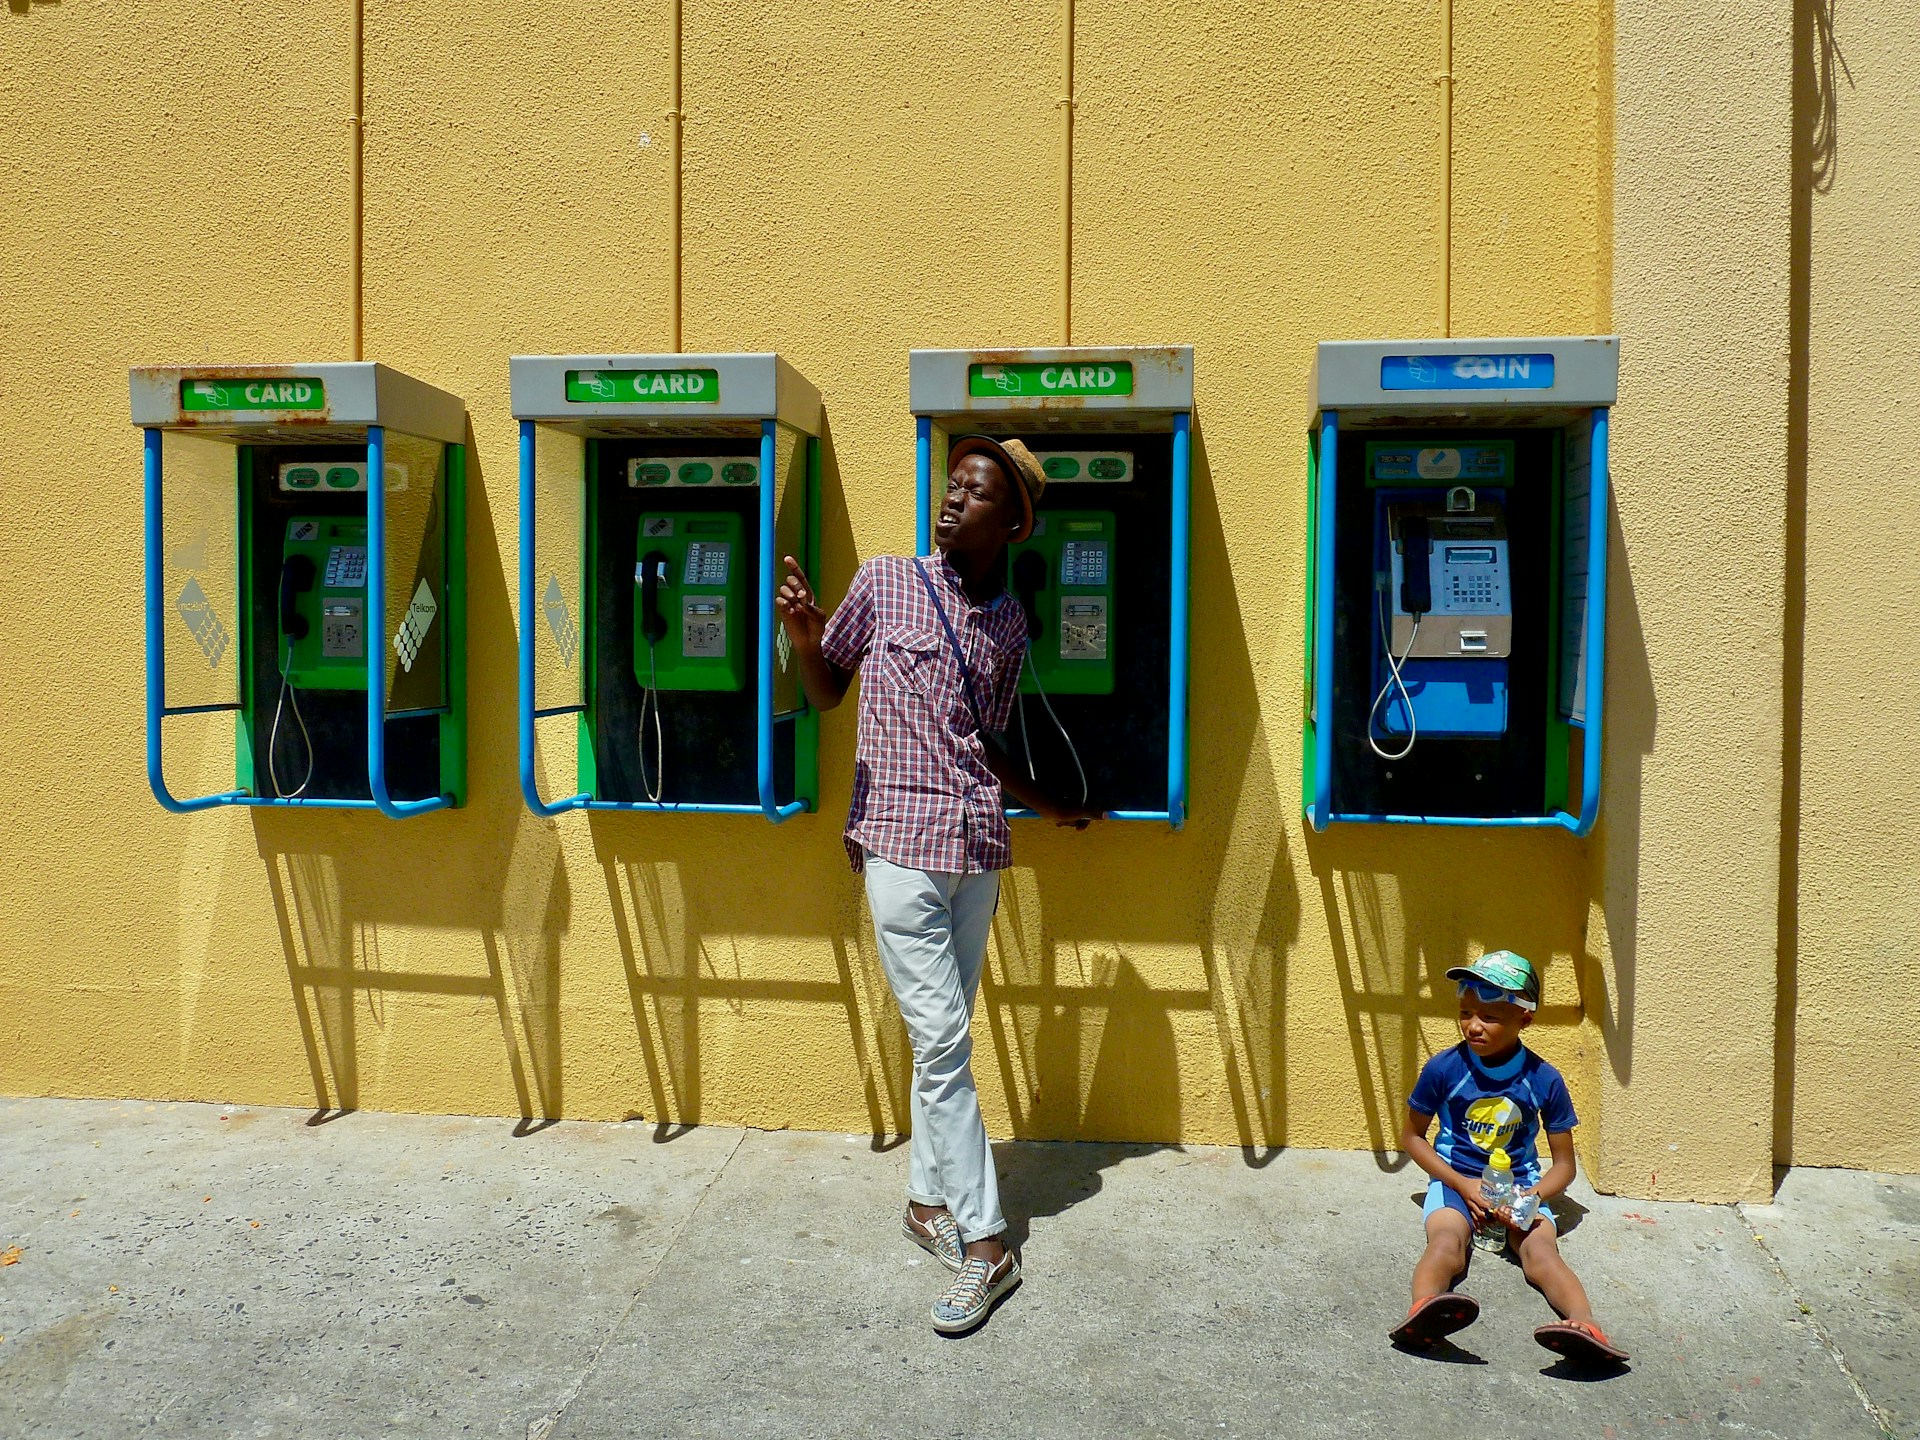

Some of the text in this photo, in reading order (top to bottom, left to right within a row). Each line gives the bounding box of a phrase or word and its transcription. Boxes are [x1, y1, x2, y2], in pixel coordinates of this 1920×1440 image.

[1040, 366, 1117, 389] CARD
[1452, 356, 1530, 380] COIN
[244, 382, 312, 404] CARD
[633, 373, 705, 395] CARD
[412, 602, 436, 613] Telkom
